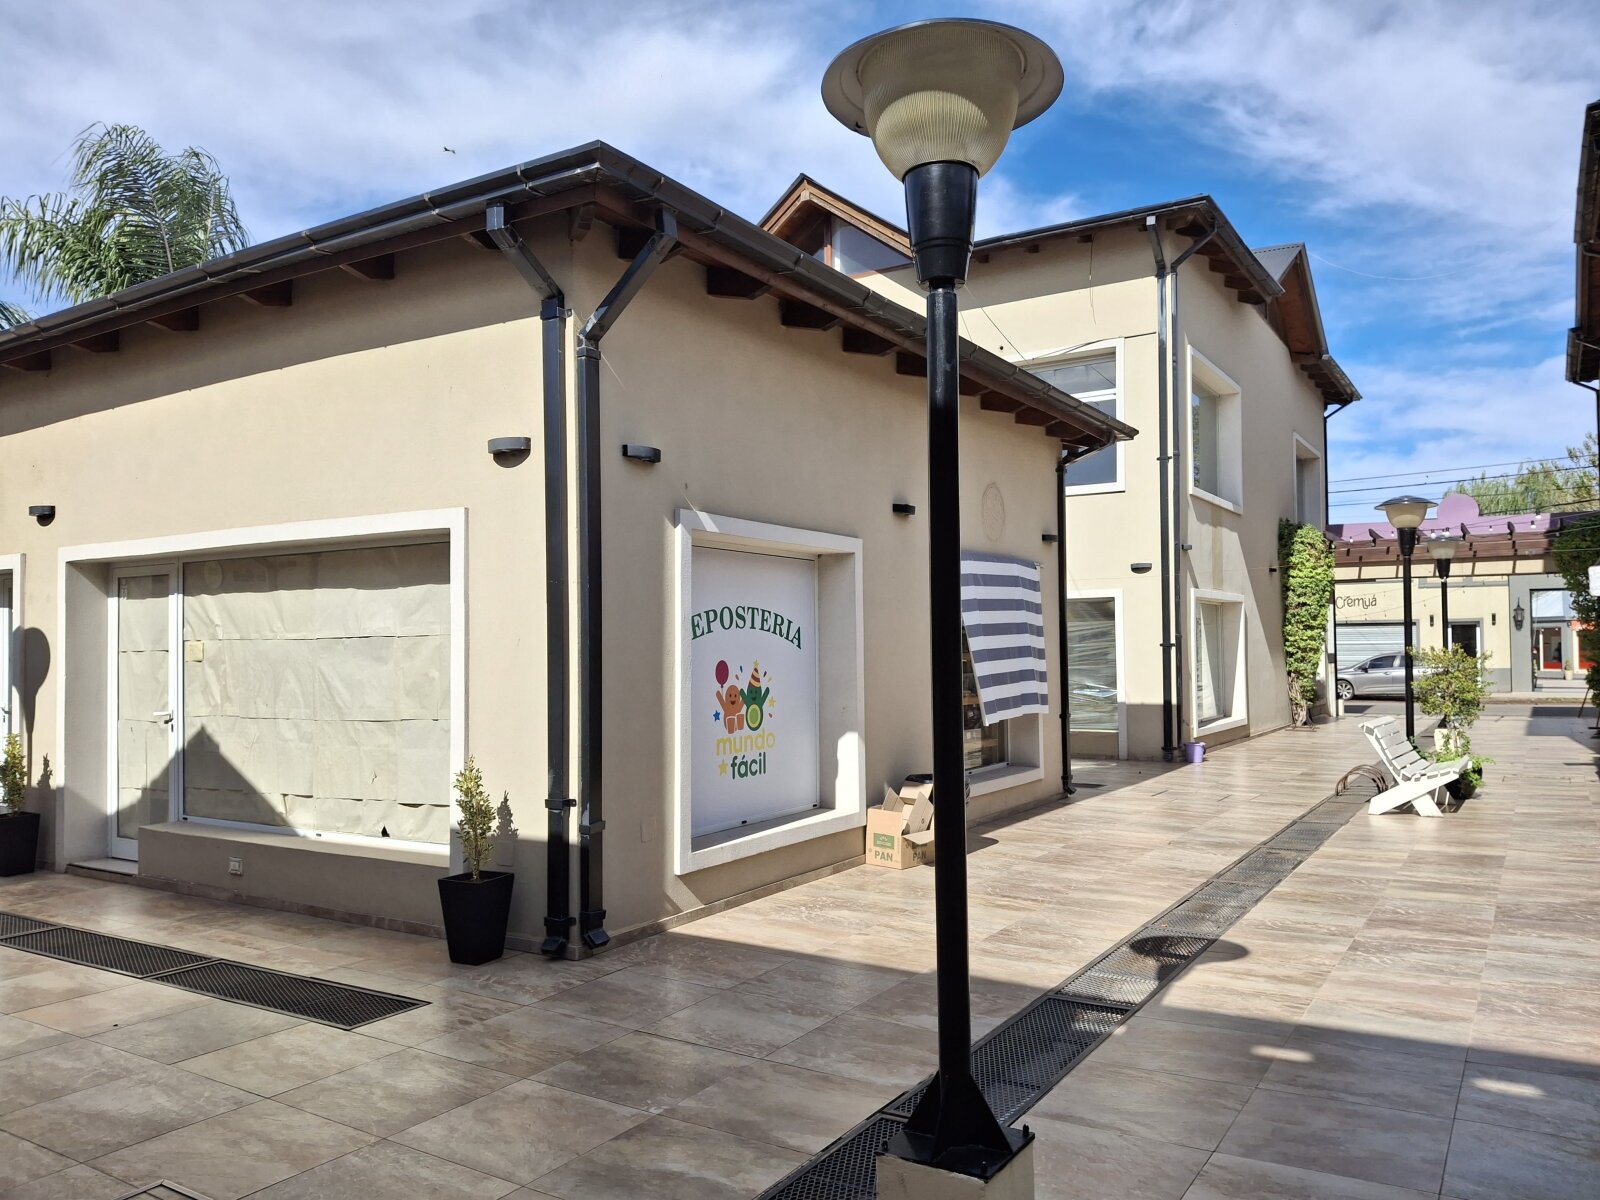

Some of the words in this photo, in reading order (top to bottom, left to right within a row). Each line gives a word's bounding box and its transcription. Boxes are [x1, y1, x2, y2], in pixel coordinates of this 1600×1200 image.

[715, 728, 776, 757] mundo
[731, 751, 766, 780] fácil
[874, 850, 893, 862] PAN
